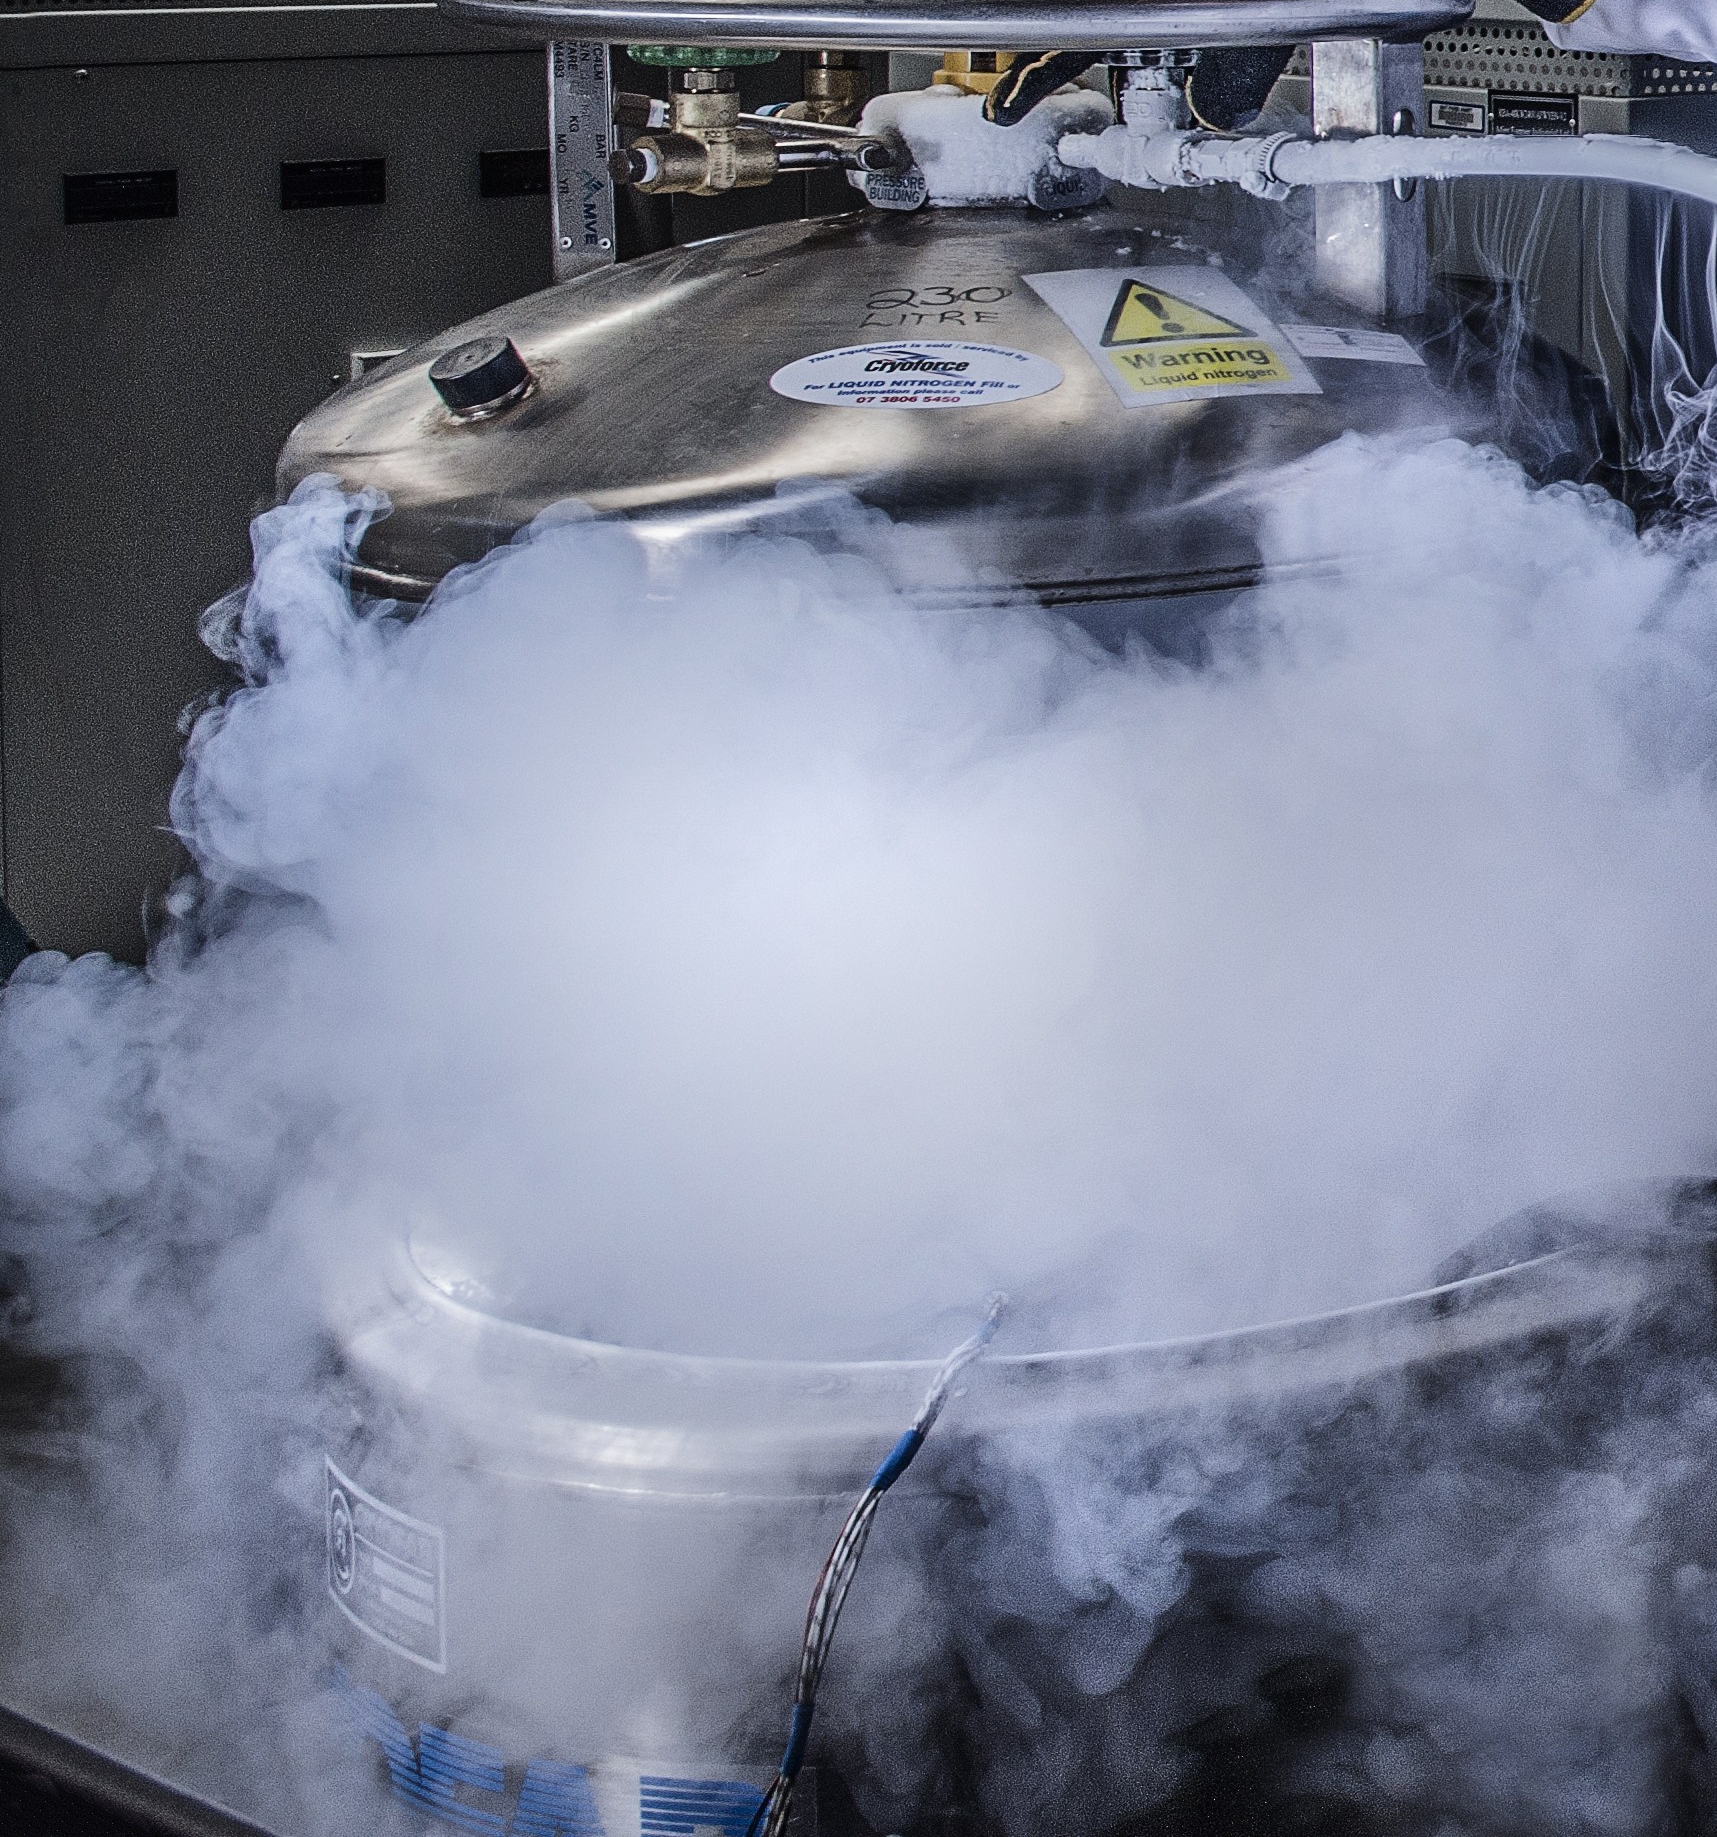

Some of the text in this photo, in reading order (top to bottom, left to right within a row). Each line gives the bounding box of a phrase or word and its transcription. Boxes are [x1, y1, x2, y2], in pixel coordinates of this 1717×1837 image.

[569, 115, 580, 133] KG
[557, 133, 567, 154] MO
[595, 133, 606, 160] BAR
[559, 177, 569, 194] YR
[866, 173, 925, 190] PRESSURE
[869, 186, 921, 203] BUILDING
[583, 202, 599, 246] MVE
[866, 286, 1012, 310] 230
[859, 310, 1000, 328] LITRE
[809, 352, 836, 364] This
[838, 342, 908, 357] equipment
[962, 344, 1015, 357] serviced
[1017, 352, 1031, 362] by
[1122, 344, 1271, 371] Warning
[864, 359, 970, 374] Cryoforce
[804, 383, 826, 391] For
[828, 380, 886, 390] LIQUID
[890, 380, 976, 388] NITROGEN
[1140, 366, 1278, 387] Liquid nitrogen
[880, 395, 918, 403] 3806
[922, 395, 961, 403] 5450
